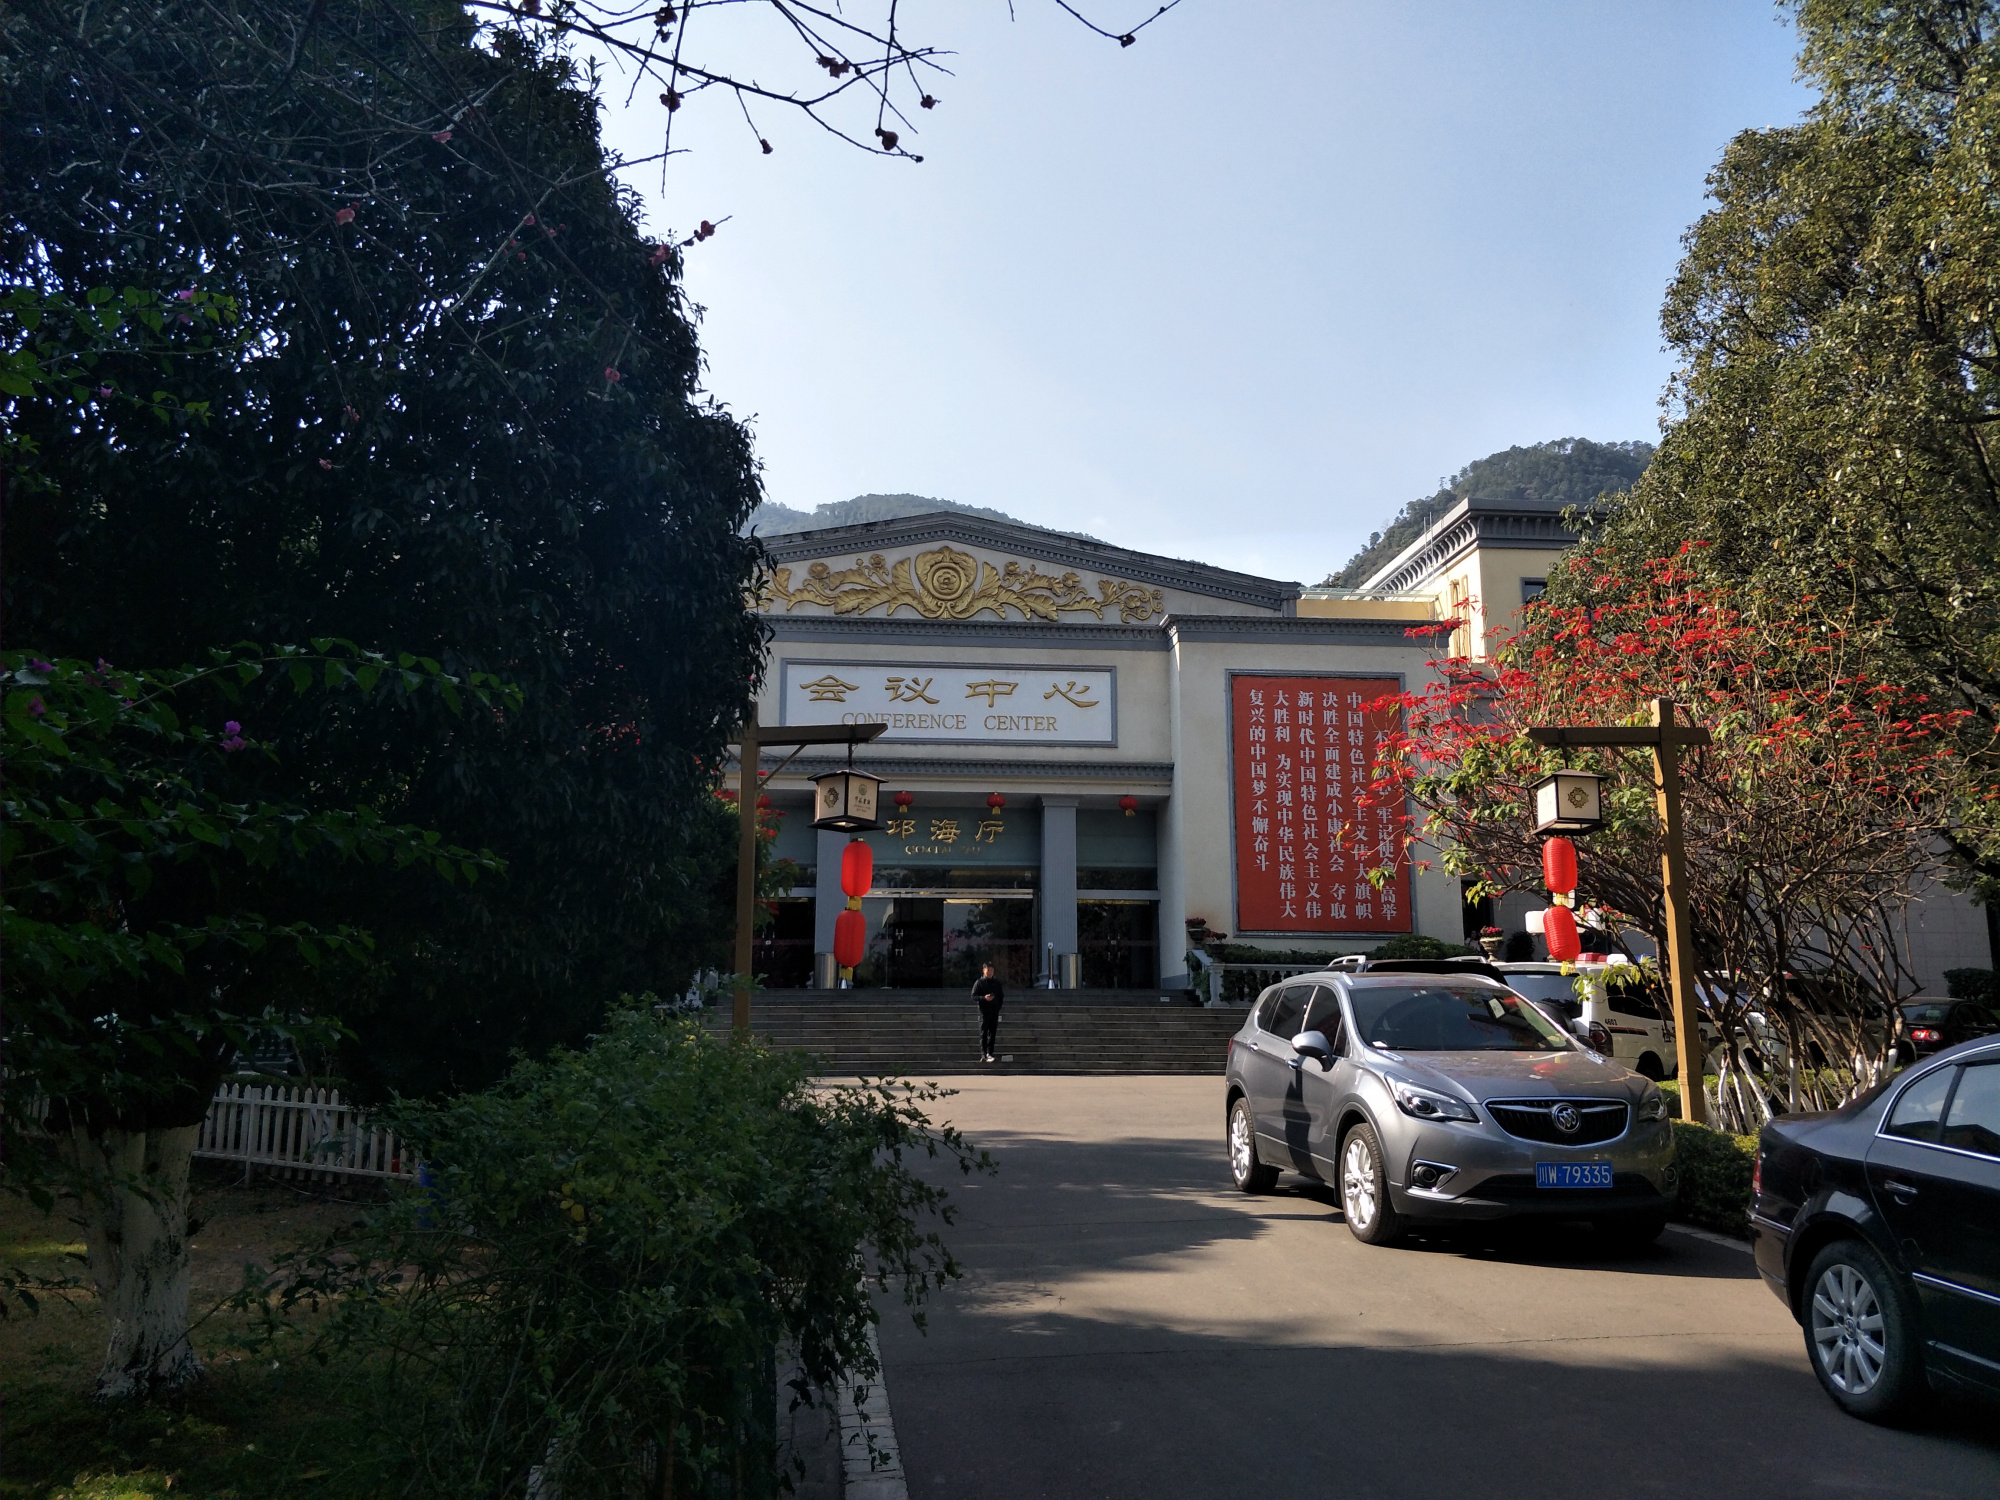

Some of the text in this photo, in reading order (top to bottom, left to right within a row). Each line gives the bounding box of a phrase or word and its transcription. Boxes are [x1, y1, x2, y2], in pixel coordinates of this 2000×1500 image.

[799, 674, 1100, 709] 会议中心
[841, 712, 1058, 732] CONFERENCE CENTER
[1249, 689, 1270, 872] 复兴的中国梦不懈奋斗
[886, 818, 1005, 844] 邛海厅
[1273, 690, 1297, 919] 大胜利 为实现中华民族伟大
[1297, 690, 1322, 919] 新时代中国特色社会主义伟
[1322, 691, 1347, 920] 决胜全面建成小康社会 夺取
[1347, 692, 1372, 920] 中国特色社会主义伟大旗帜
